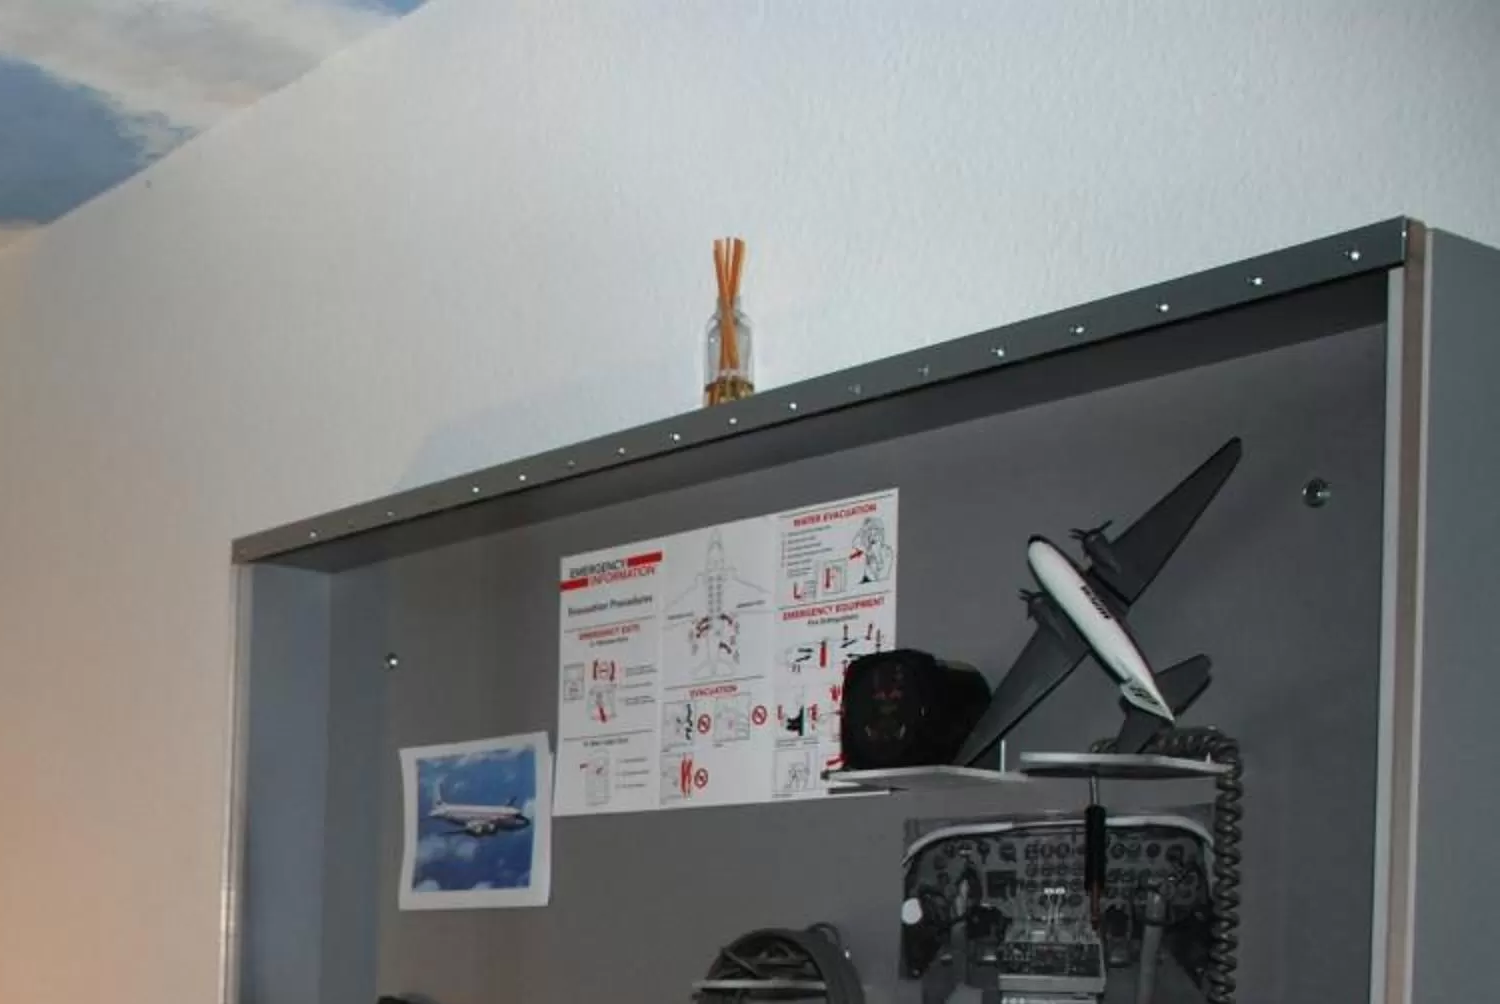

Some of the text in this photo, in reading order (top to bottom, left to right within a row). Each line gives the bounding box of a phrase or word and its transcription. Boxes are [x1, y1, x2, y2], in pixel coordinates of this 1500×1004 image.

[793, 503, 877, 527] WATER EVACUATION
[569, 559, 626, 578] EMERGENCY
[588, 566, 656, 587] INFORMATION
[783, 597, 885, 621] EMERGENCY EQUIPMENT
[689, 685, 738, 698] EVACUATION
